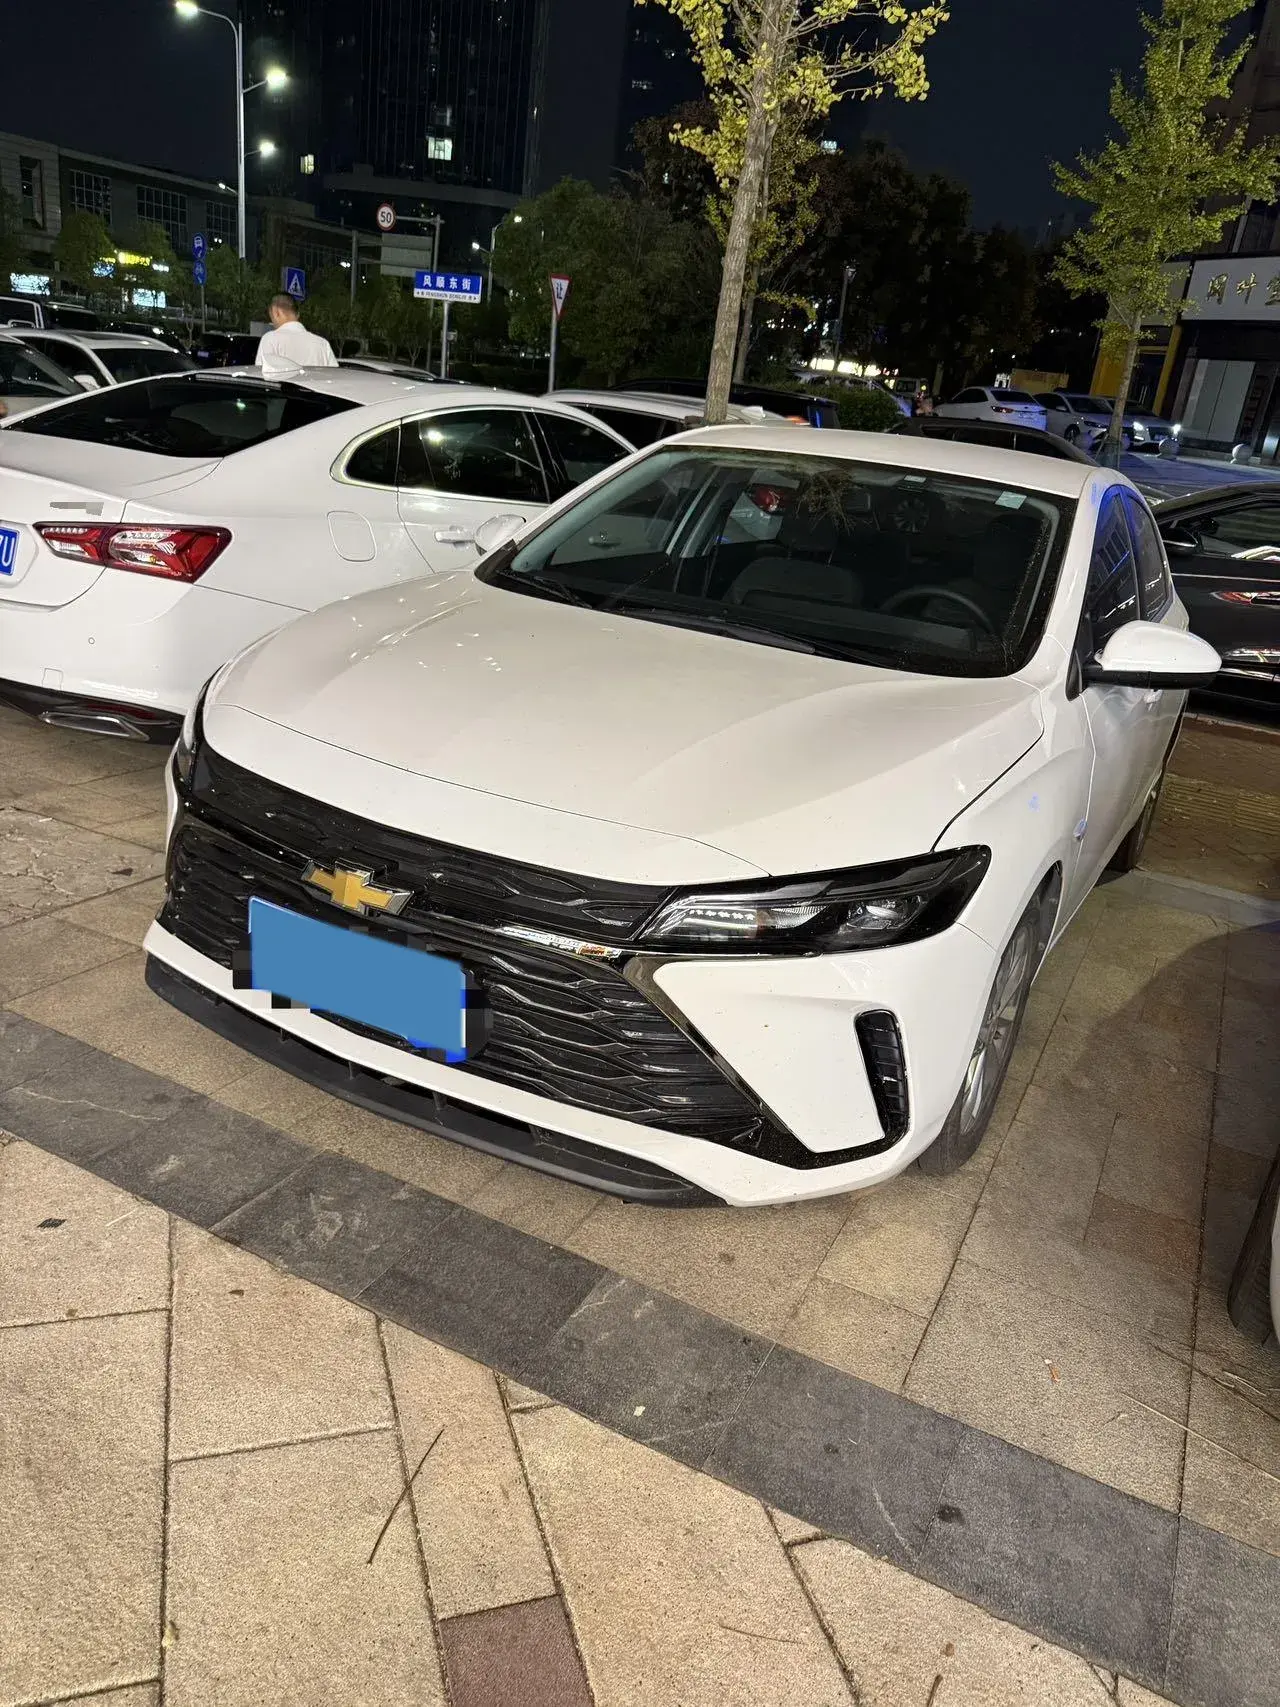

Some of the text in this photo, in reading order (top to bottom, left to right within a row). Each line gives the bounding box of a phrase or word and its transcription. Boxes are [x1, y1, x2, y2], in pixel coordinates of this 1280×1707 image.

[380, 211, 392, 223] 50
[423, 275, 471, 291] 风顺东街
[556, 281, 563, 300] 让
